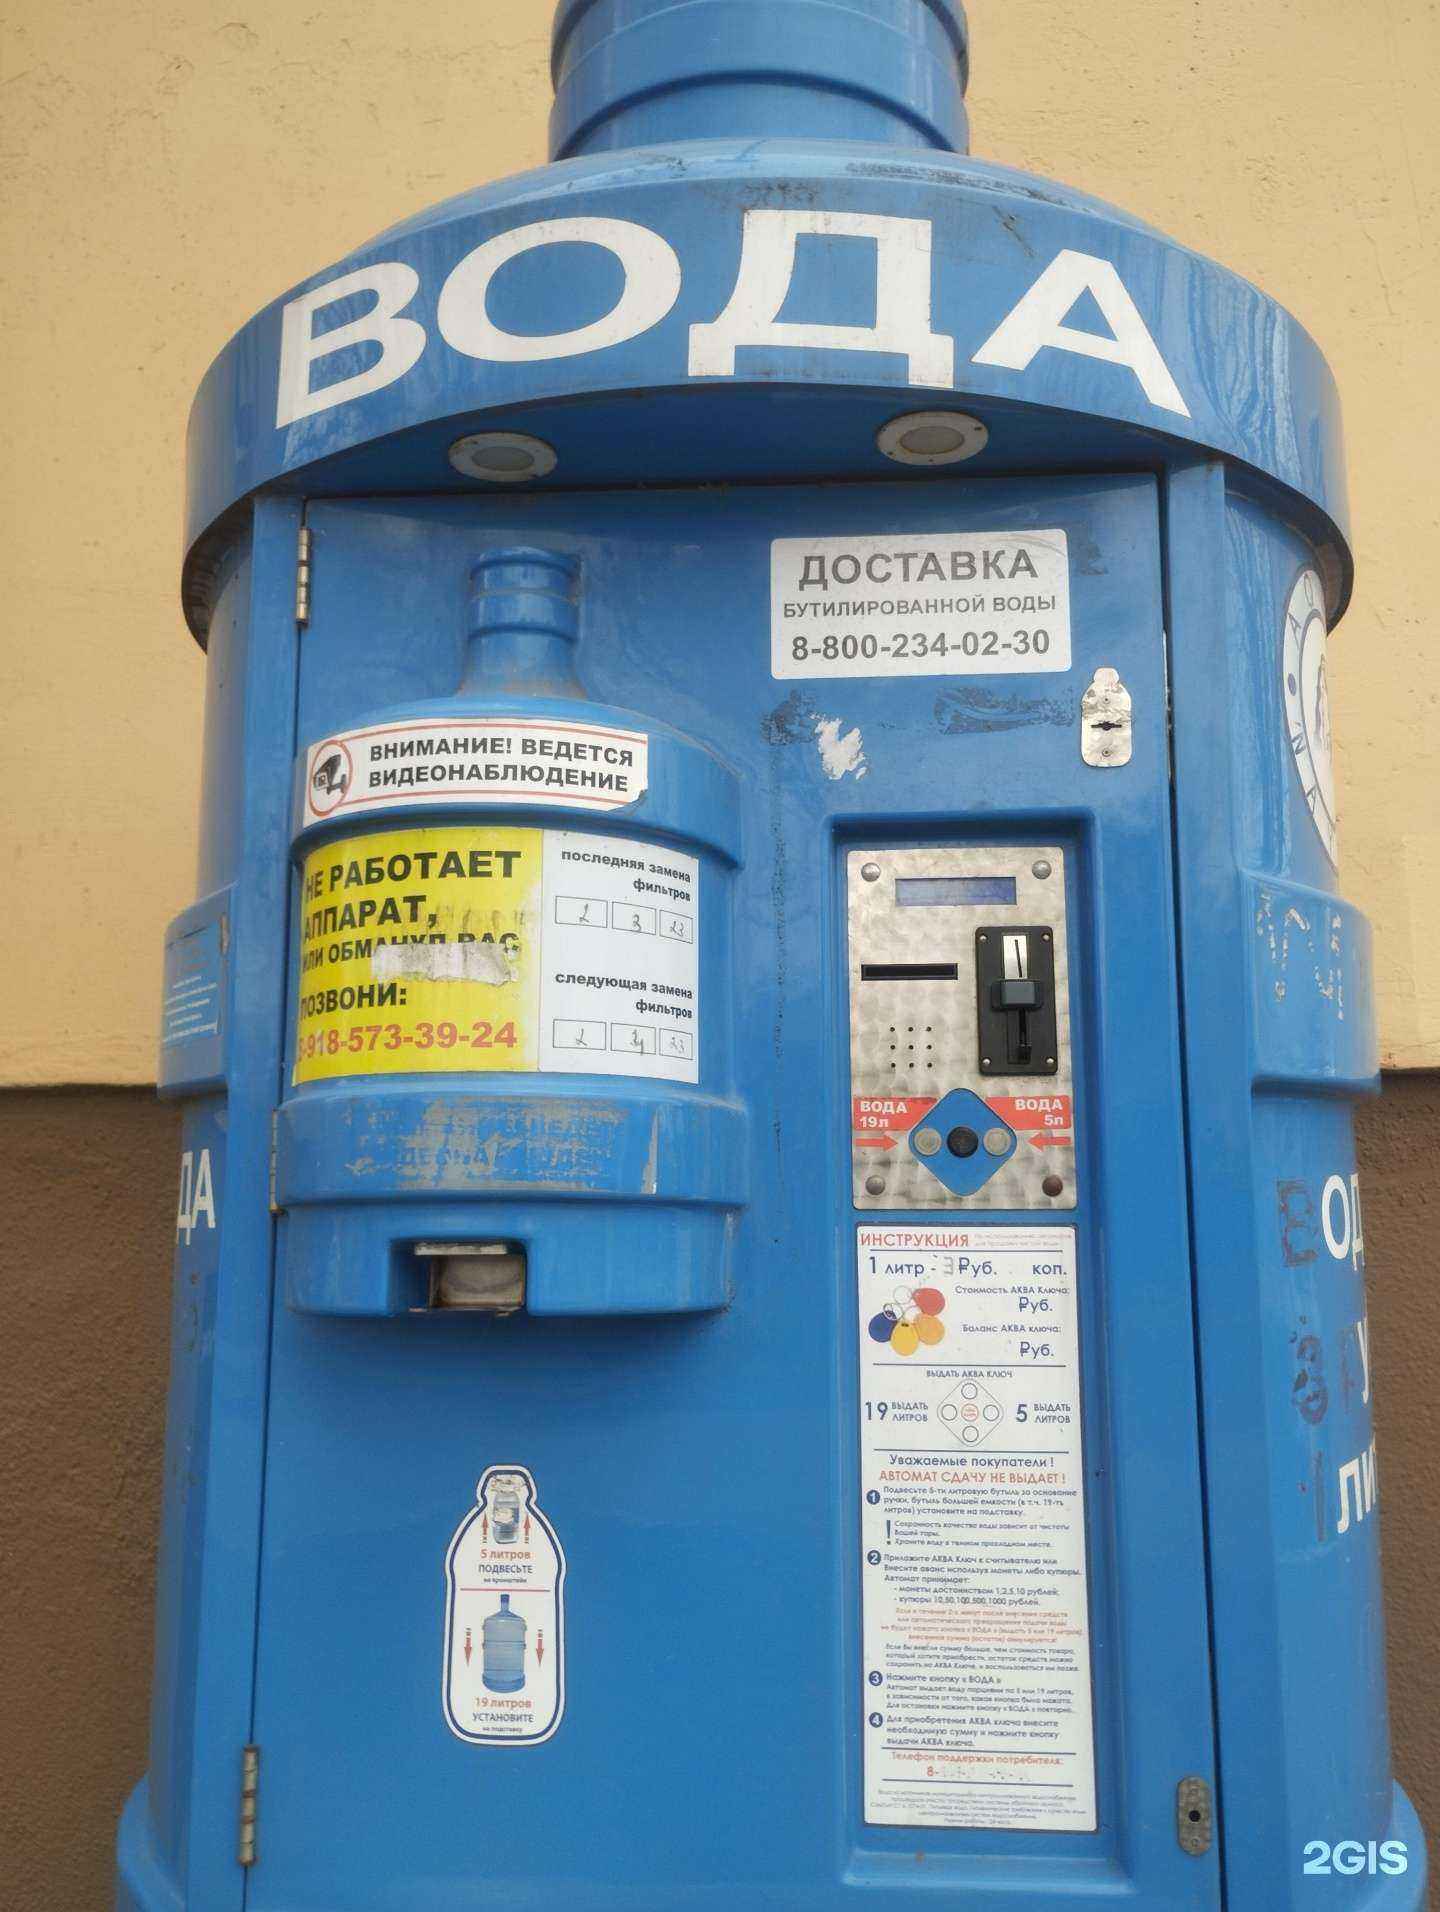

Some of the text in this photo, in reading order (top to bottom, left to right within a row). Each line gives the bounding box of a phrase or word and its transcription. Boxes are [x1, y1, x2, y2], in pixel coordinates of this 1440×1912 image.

[276, 207, 1192, 430] ВОДА
[797, 548, 1039, 592] ДОСТАВКА
[783, 593, 1056, 619] БУТИЛИРОВАННОЙ ВОДЫ
[791, 628, 1051, 661] 8-800-234-02-30
[370, 737, 634, 767] ВНИМАНИЕ! ВЕДЕТСЯ
[368, 764, 629, 793] ВИДЕОНАБЛЮДЕНИЕ
[328, 850, 522, 892] РАБОТАЕТ
[561, 849, 691, 883] последняя замена
[632, 878, 691, 902] фильтров
[304, 895, 438, 942] АППАРАТ,
[555, 971, 693, 1000] следующая замена
[300, 982, 407, 1021] ПОЗВОНИ:
[635, 999, 693, 1019] фильтров
[860, 1098, 1063, 1115] ВОДА ВОДА
[860, 1114, 1064, 1128] 19л 5л
[860, 1233, 969, 1248] ИНСТРУКЦИЯ
[869, 1256, 876, 1274] 1
[885, 1264, 925, 1277] литр
[1032, 1264, 1068, 1275] коп.
[955, 1286, 1008, 1295] Стоимость
[1010, 1286, 1035, 1294] АКВА
[963, 1324, 998, 1333] Баланс
[1000, 1324, 1026, 1334] АКВА
[926, 1370, 1013, 1379] ВЫДАТЬ АКВА КЛЮЧ
[865, 1401, 929, 1422] 19 ВЫДАТЬ
[892, 1413, 929, 1423] ЛИТРОВ
[1016, 1403, 1072, 1423] 5 ВЫДАТЬ
[1034, 1415, 1071, 1425] ЛИТРОВ
[889, 1454, 968, 1467] Уважаемые
[971, 1456, 1047, 1469] покупатели
[879, 1470, 938, 1483] АВТОМАТ
[941, 1471, 987, 1485] СДАЧУ
[990, 1472, 1006, 1484] НЕ
[1009, 1472, 1059, 1485] ВЫДАЕТ
[884, 1486, 928, 1495] Подвесьте
[990, 1488, 1020, 1497] бутыль
[480, 1549, 531, 1561] 5 литров
[479, 1564, 533, 1575] ПОДВЕСЬТЕ
[476, 1697, 532, 1710] 19 литров
[472, 1712, 535, 1723] УСТАНОВИТЕ
